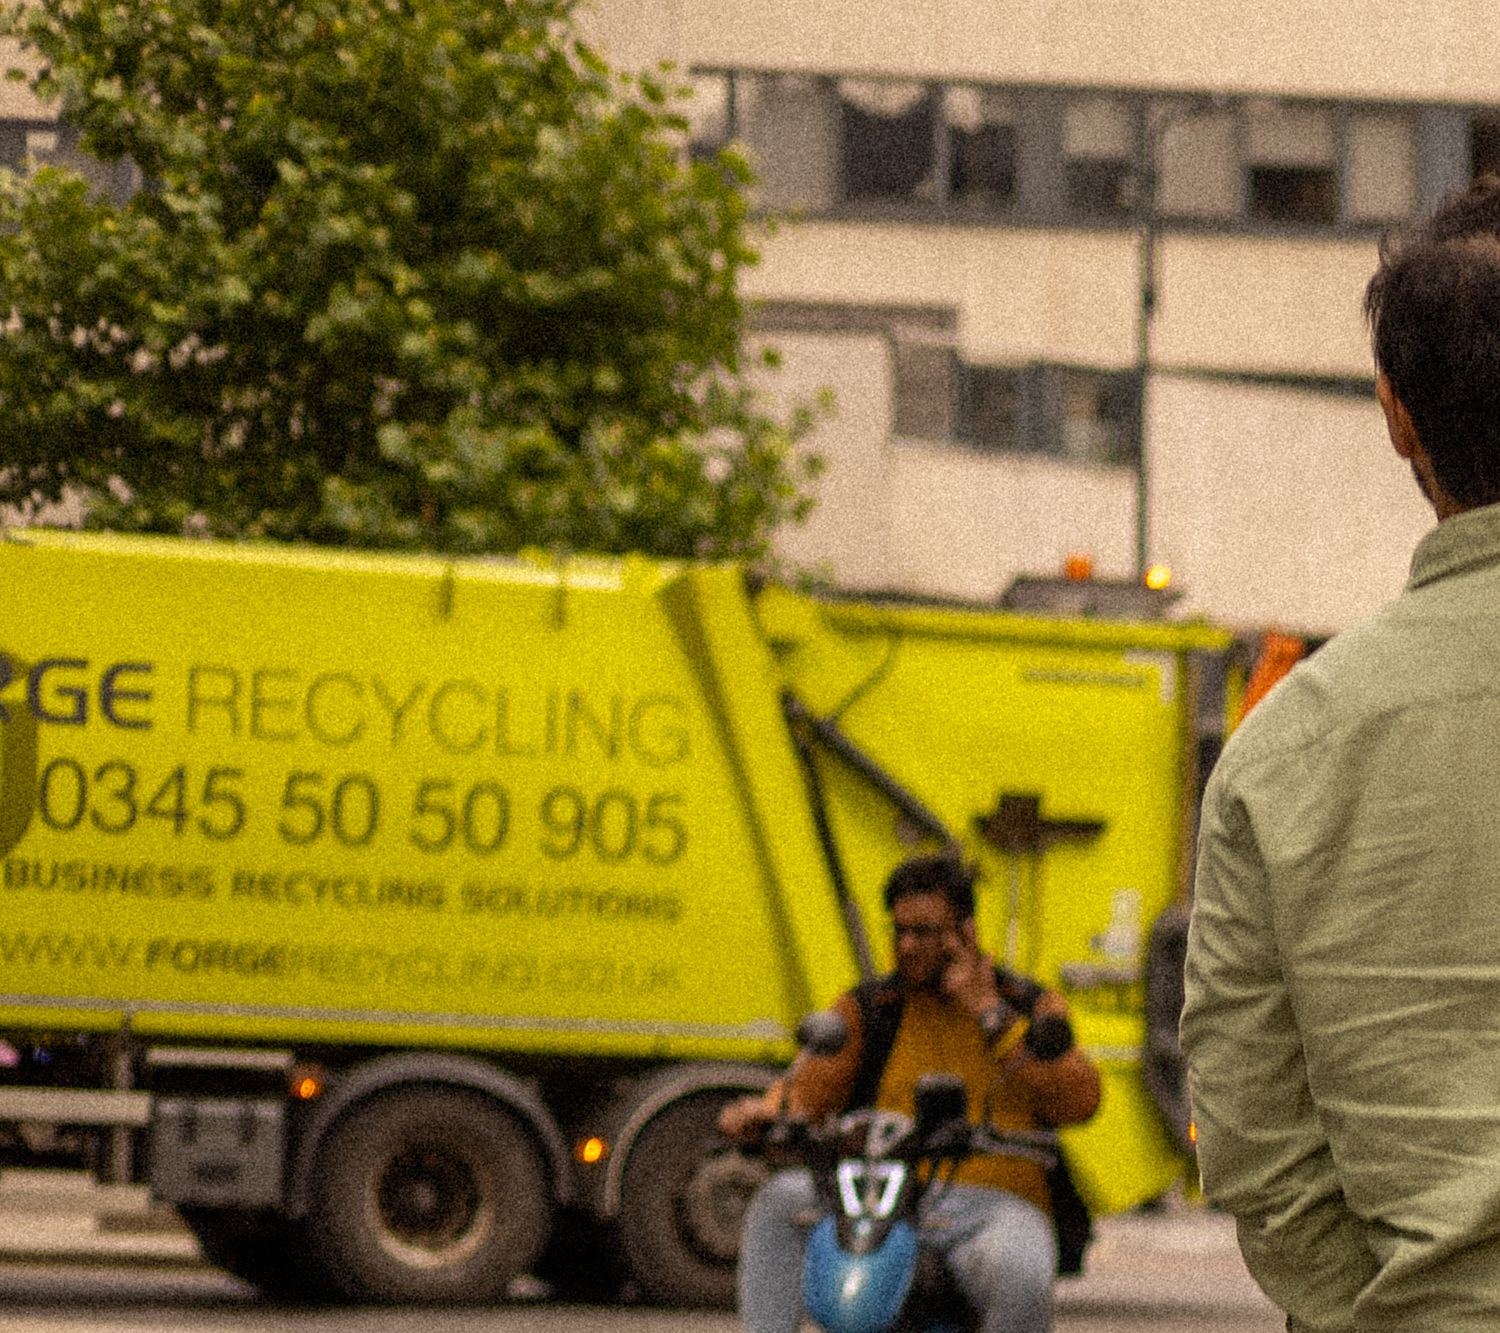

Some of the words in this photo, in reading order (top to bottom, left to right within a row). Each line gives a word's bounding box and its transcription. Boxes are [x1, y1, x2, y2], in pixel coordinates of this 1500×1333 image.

[0, 655, 155, 731] GE
[186, 662, 692, 768] RECYCLING
[39, 756, 249, 842] 0345
[276, 768, 381, 850] 50
[407, 776, 512, 858] 50
[537, 784, 689, 867] 905
[4, 859, 216, 899] BUSINESS
[230, 868, 446, 912] RECYCLING
[460, 880, 684, 924] SOLUTIONS
